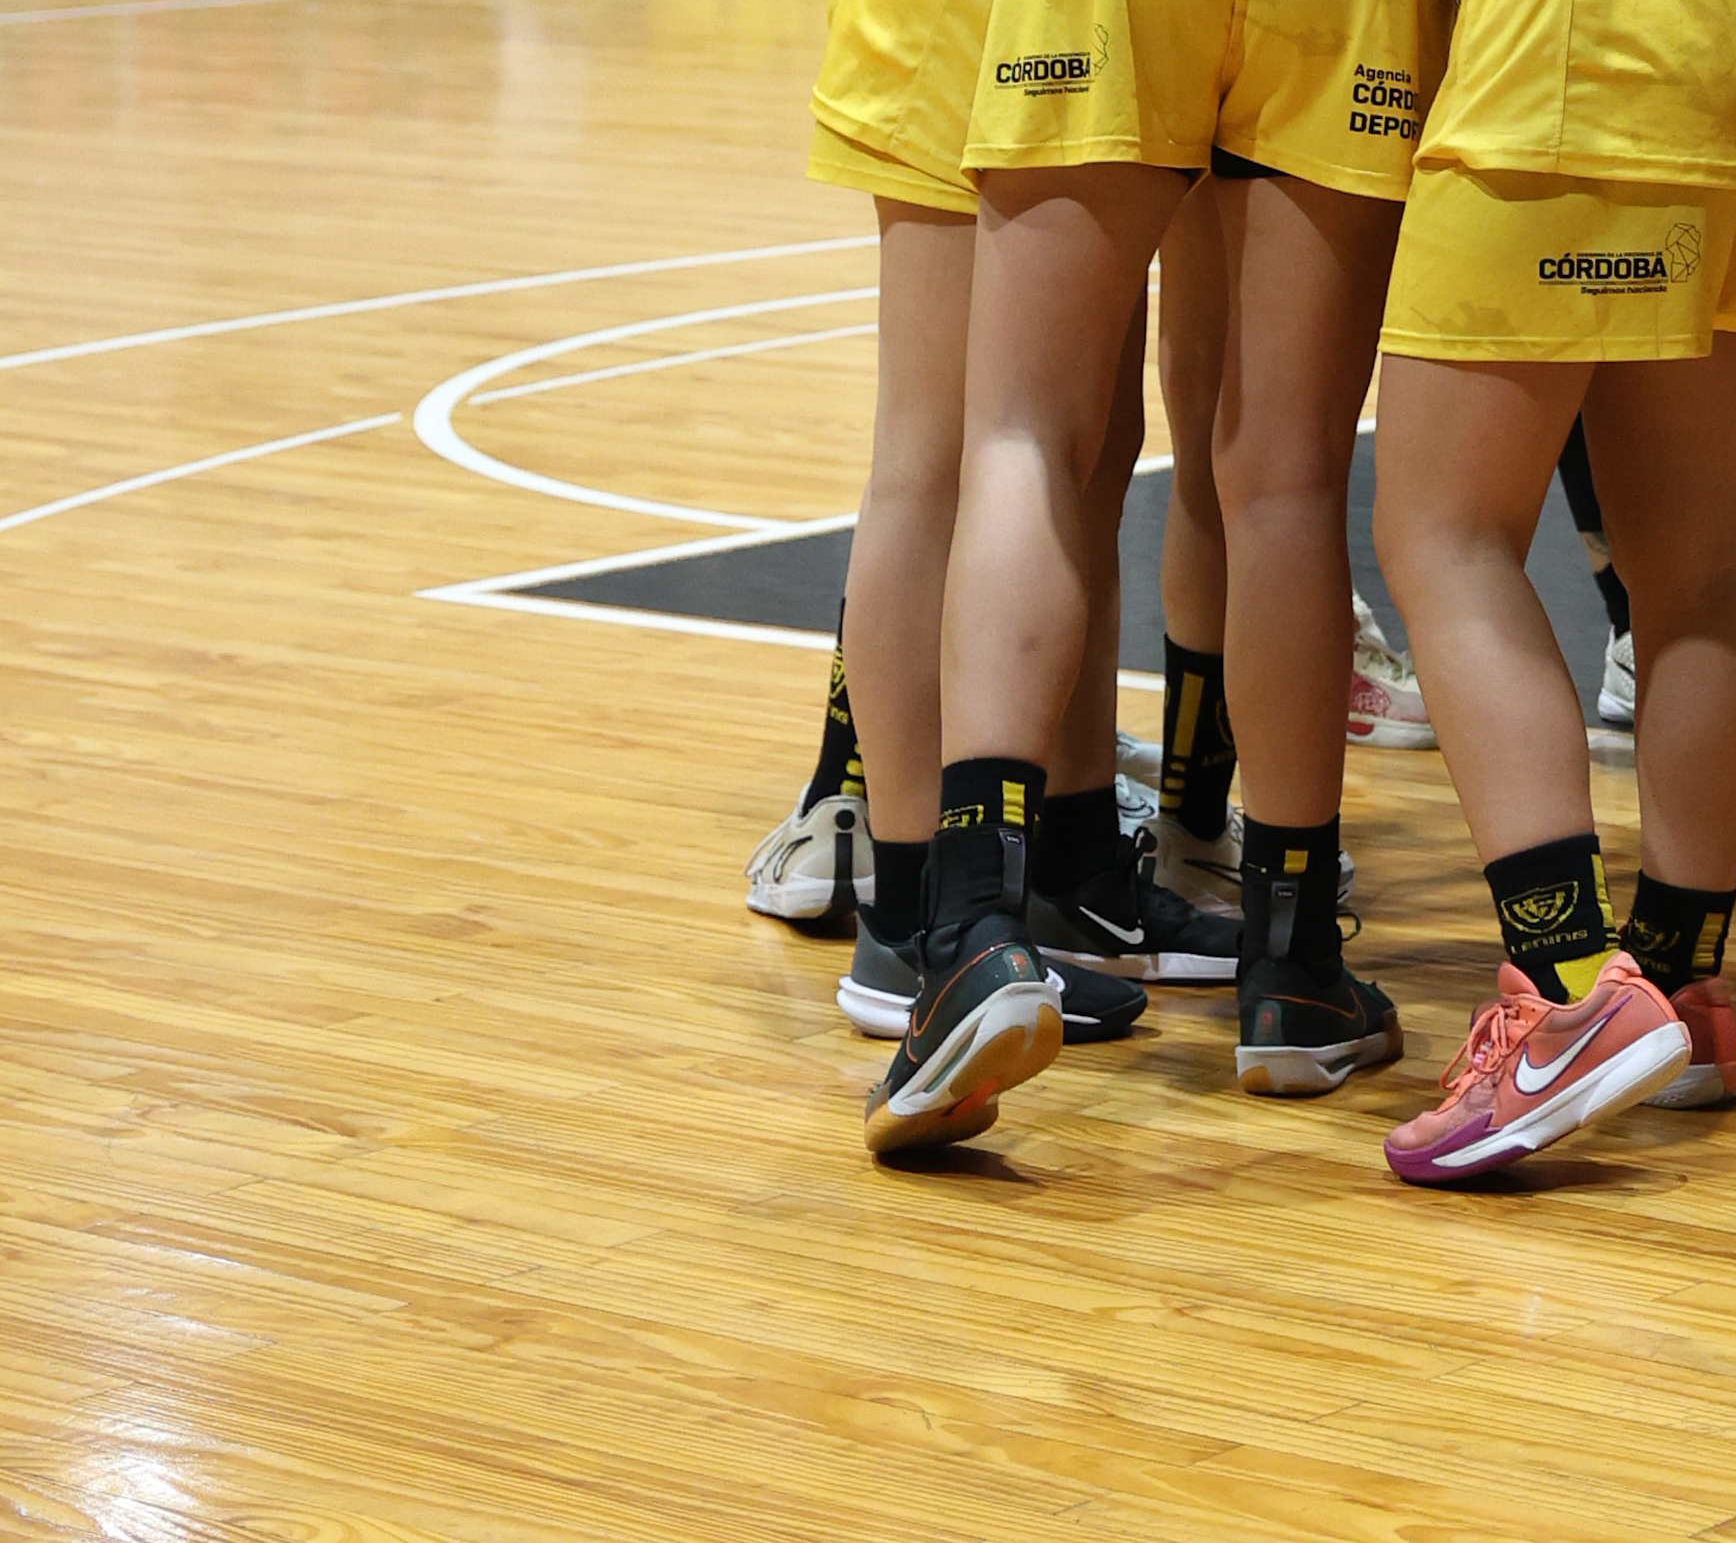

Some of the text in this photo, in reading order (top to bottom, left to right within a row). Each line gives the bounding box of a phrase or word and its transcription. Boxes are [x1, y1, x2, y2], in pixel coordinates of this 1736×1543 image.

[996, 57, 1090, 83] CÓRDOBA
[1354, 63, 1412, 84] Agencia
[1539, 252, 1667, 280] CÓRDOBA
